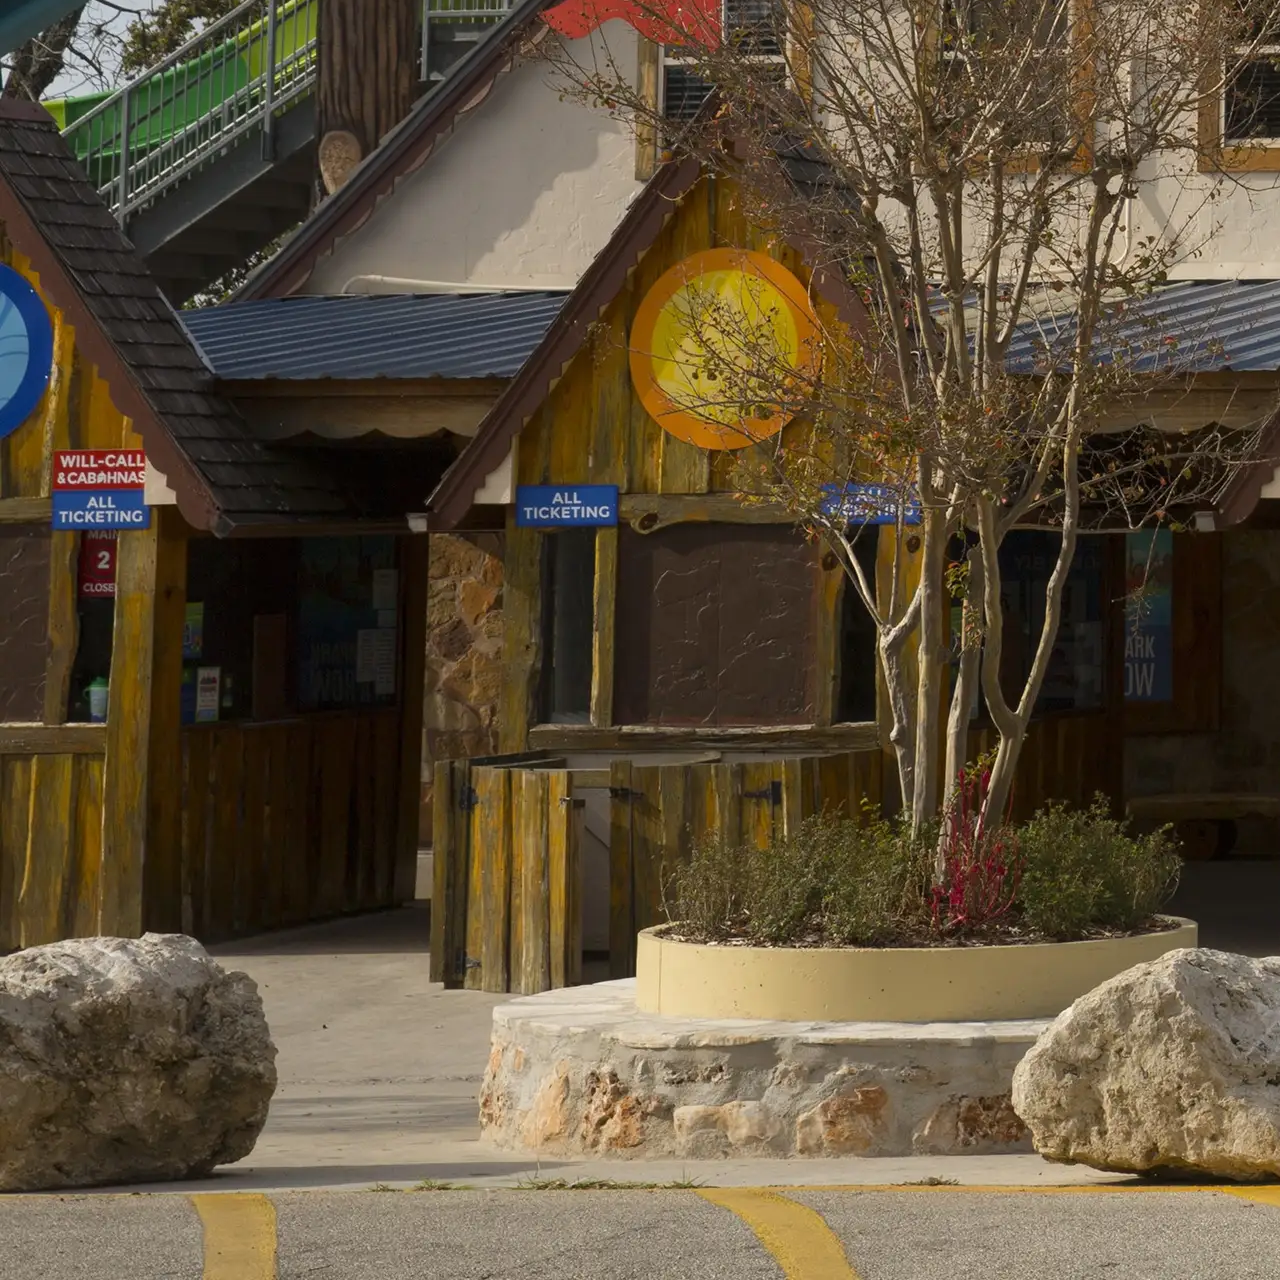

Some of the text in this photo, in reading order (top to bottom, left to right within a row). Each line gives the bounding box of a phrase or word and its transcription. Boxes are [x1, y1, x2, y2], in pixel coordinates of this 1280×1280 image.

[60, 454, 145, 468] WILL-CALL
[87, 496, 116, 508] ALL
[552, 492, 582, 504] ALL
[59, 510, 143, 523] TICKETING
[523, 506, 610, 519] TICKETING
[97, 551, 110, 569] 2
[83, 583, 117, 592] CLOSE
[1125, 635, 1156, 658] ARK
